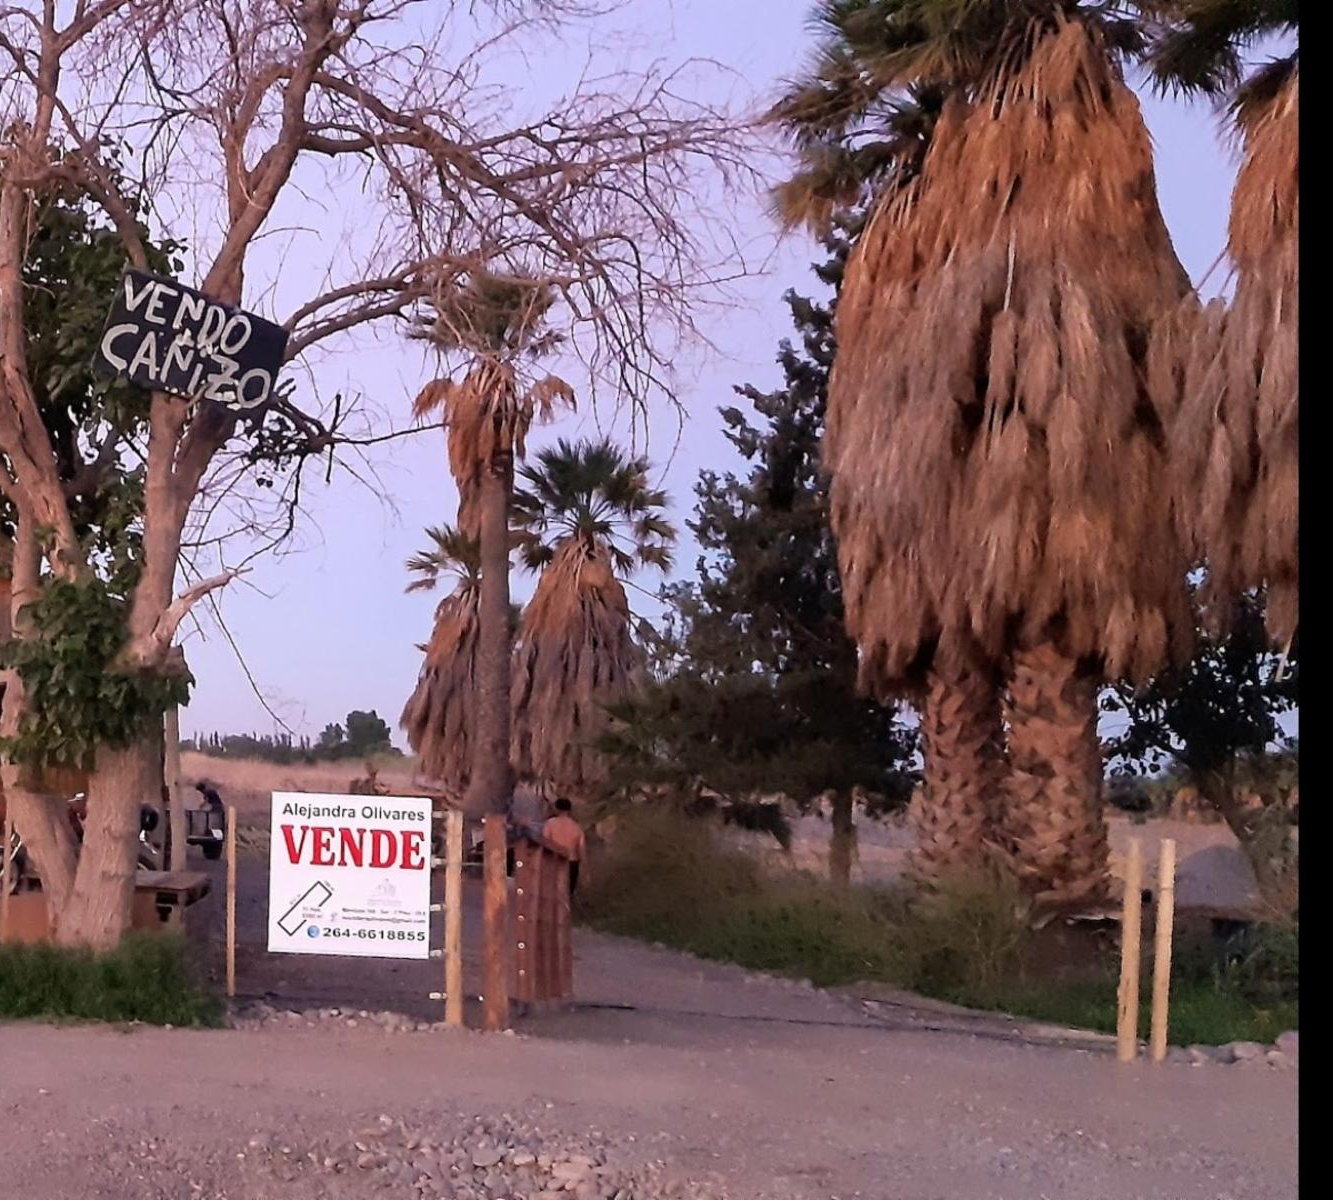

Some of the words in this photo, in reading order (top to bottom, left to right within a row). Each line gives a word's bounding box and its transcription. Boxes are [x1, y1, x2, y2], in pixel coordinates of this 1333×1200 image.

[124, 274, 252, 355] VENDO
[282, 803, 356, 819] Alejandra
[361, 806, 425, 821] Olivares
[280, 825, 425, 870] VENDE
[322, 927, 426, 941] 264-6618855
